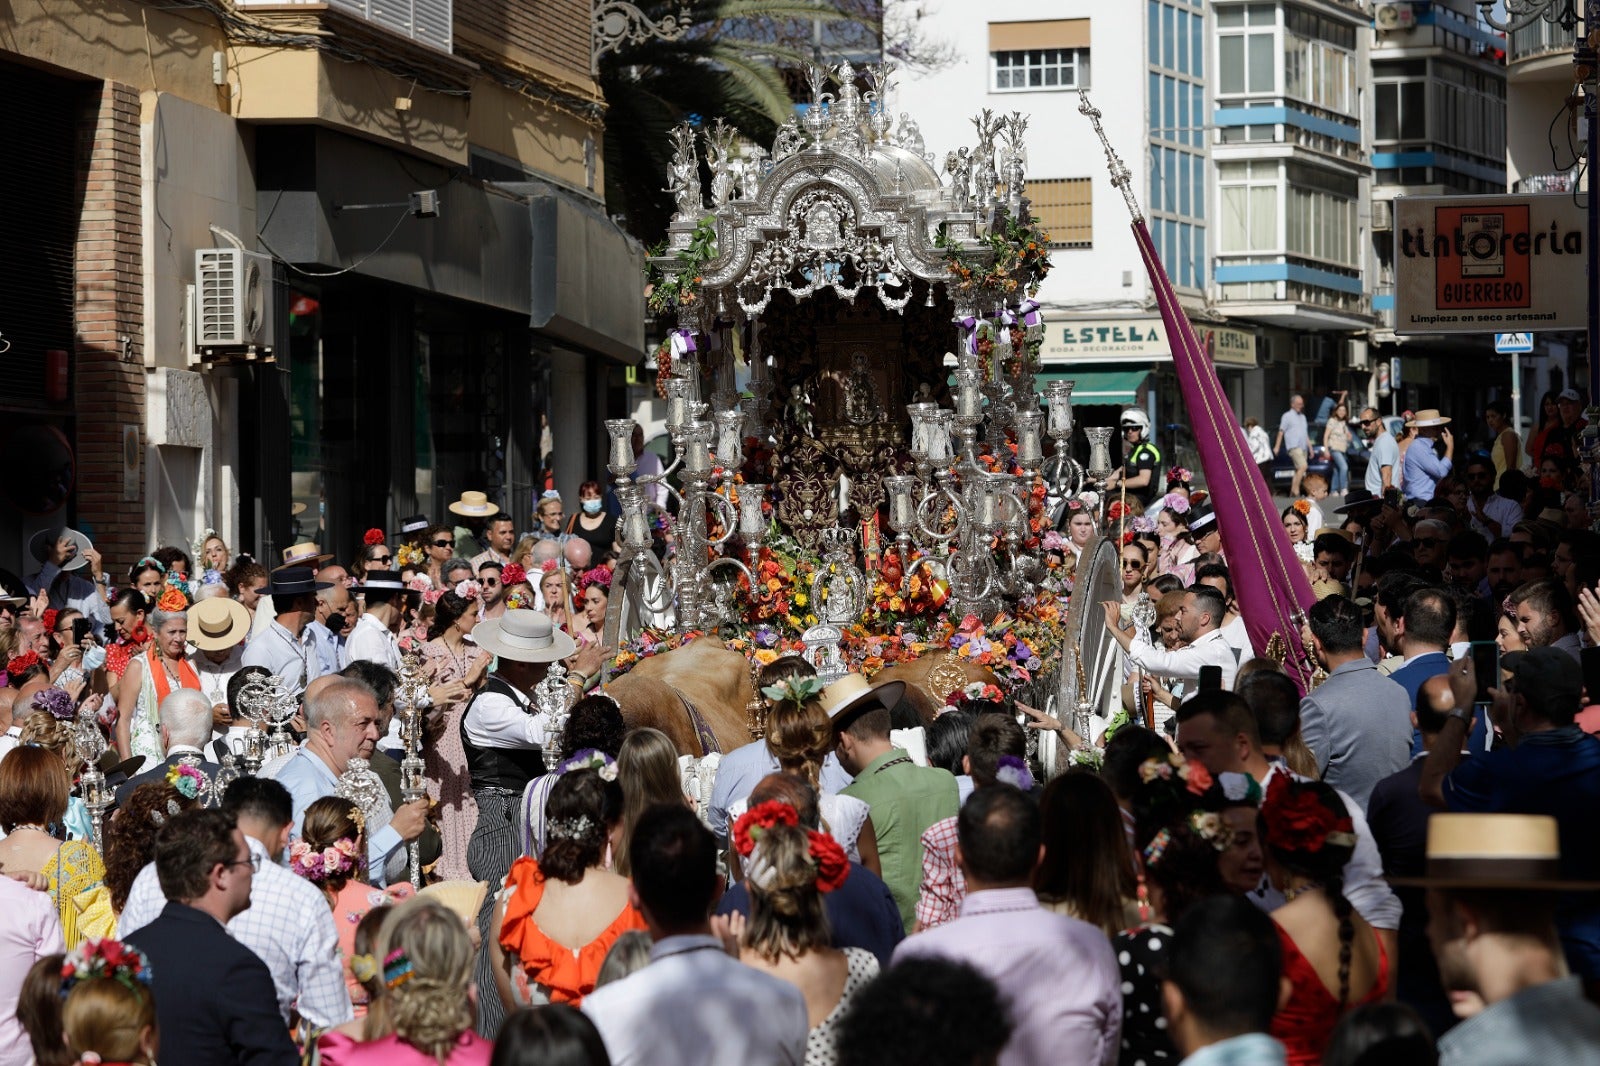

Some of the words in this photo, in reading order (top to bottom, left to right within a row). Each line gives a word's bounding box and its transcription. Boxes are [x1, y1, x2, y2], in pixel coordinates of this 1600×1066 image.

[1444, 282, 1523, 303] GUERRERO
[1411, 315, 1458, 324] Limpieza
[1477, 314, 1502, 322] seco
[1505, 312, 1557, 321] artesanal
[1063, 326, 1159, 344] ESTELA
